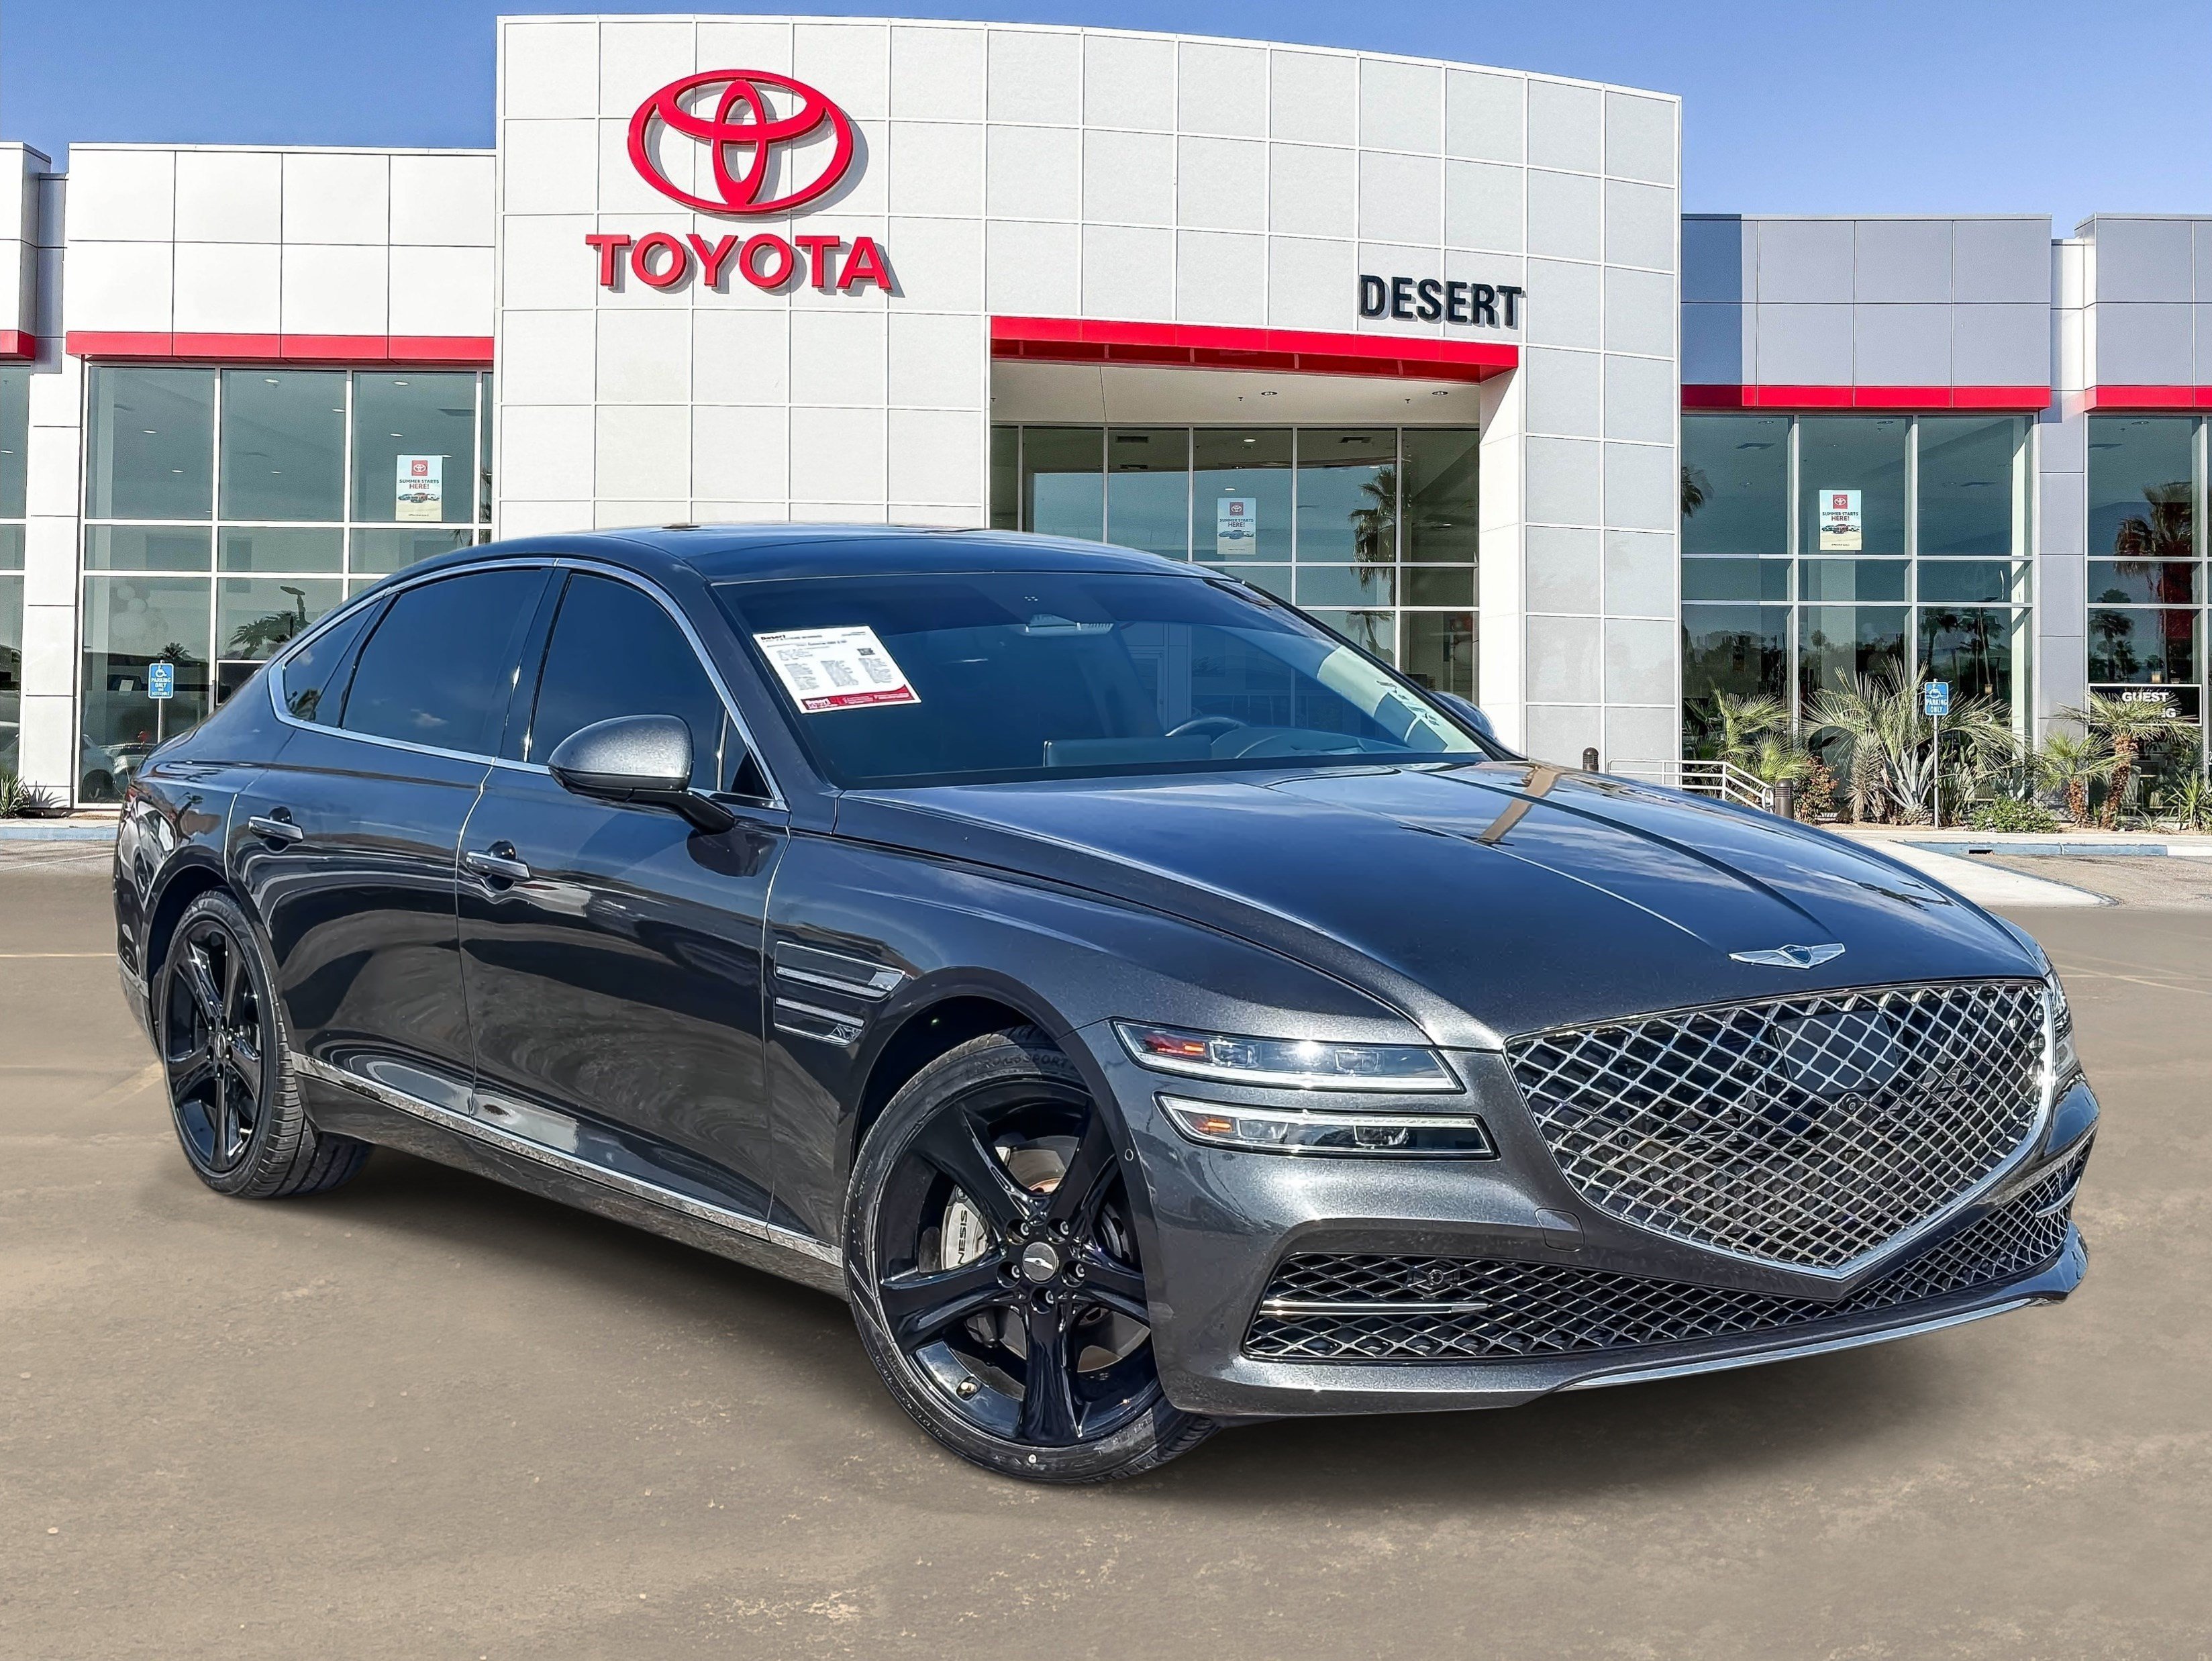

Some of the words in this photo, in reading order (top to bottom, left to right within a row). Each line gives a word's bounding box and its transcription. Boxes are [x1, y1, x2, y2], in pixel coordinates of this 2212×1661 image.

[585, 232, 893, 291] TOYOTA
[1359, 274, 1522, 327] DESERT
[2121, 691, 2170, 703] GUEST
[957, 1209, 968, 1264] NESIS
